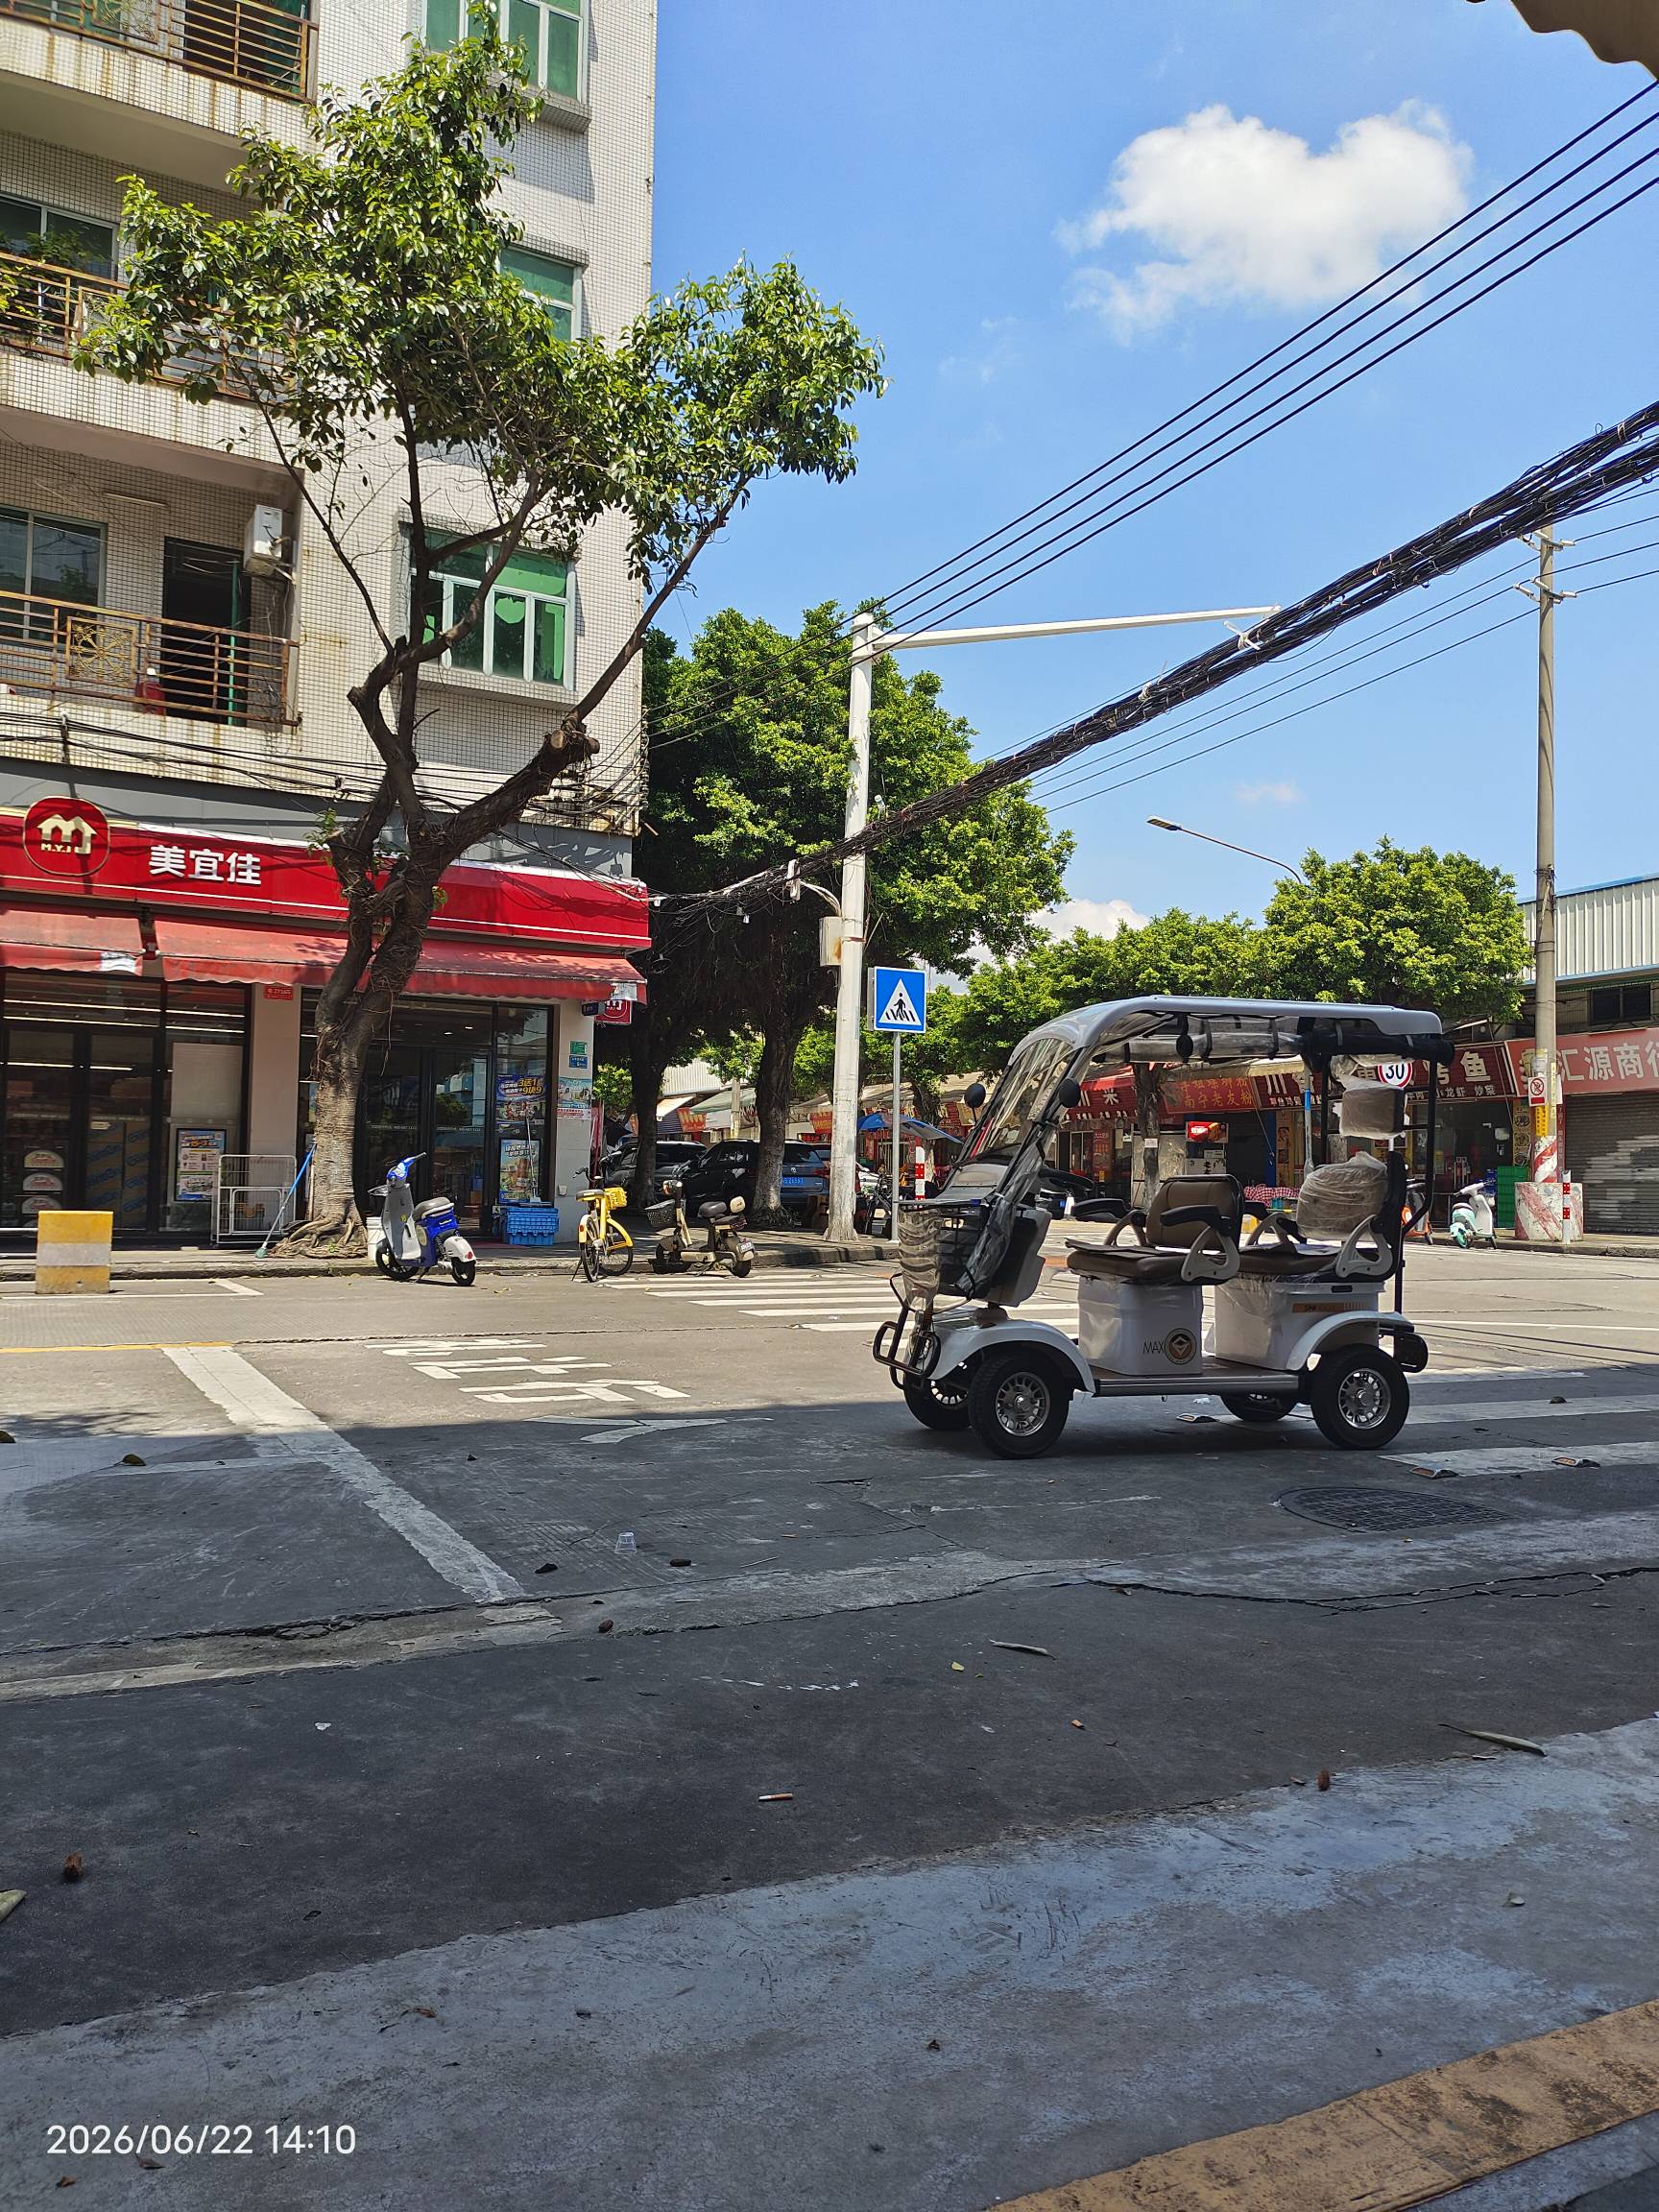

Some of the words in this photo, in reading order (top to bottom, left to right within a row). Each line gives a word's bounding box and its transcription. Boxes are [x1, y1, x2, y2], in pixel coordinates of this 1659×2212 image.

[148, 844, 262, 886] 美宜佳
[1185, 1089, 1252, 1109] 南宁老友粉
[1142, 1340, 1165, 1356] MAX
